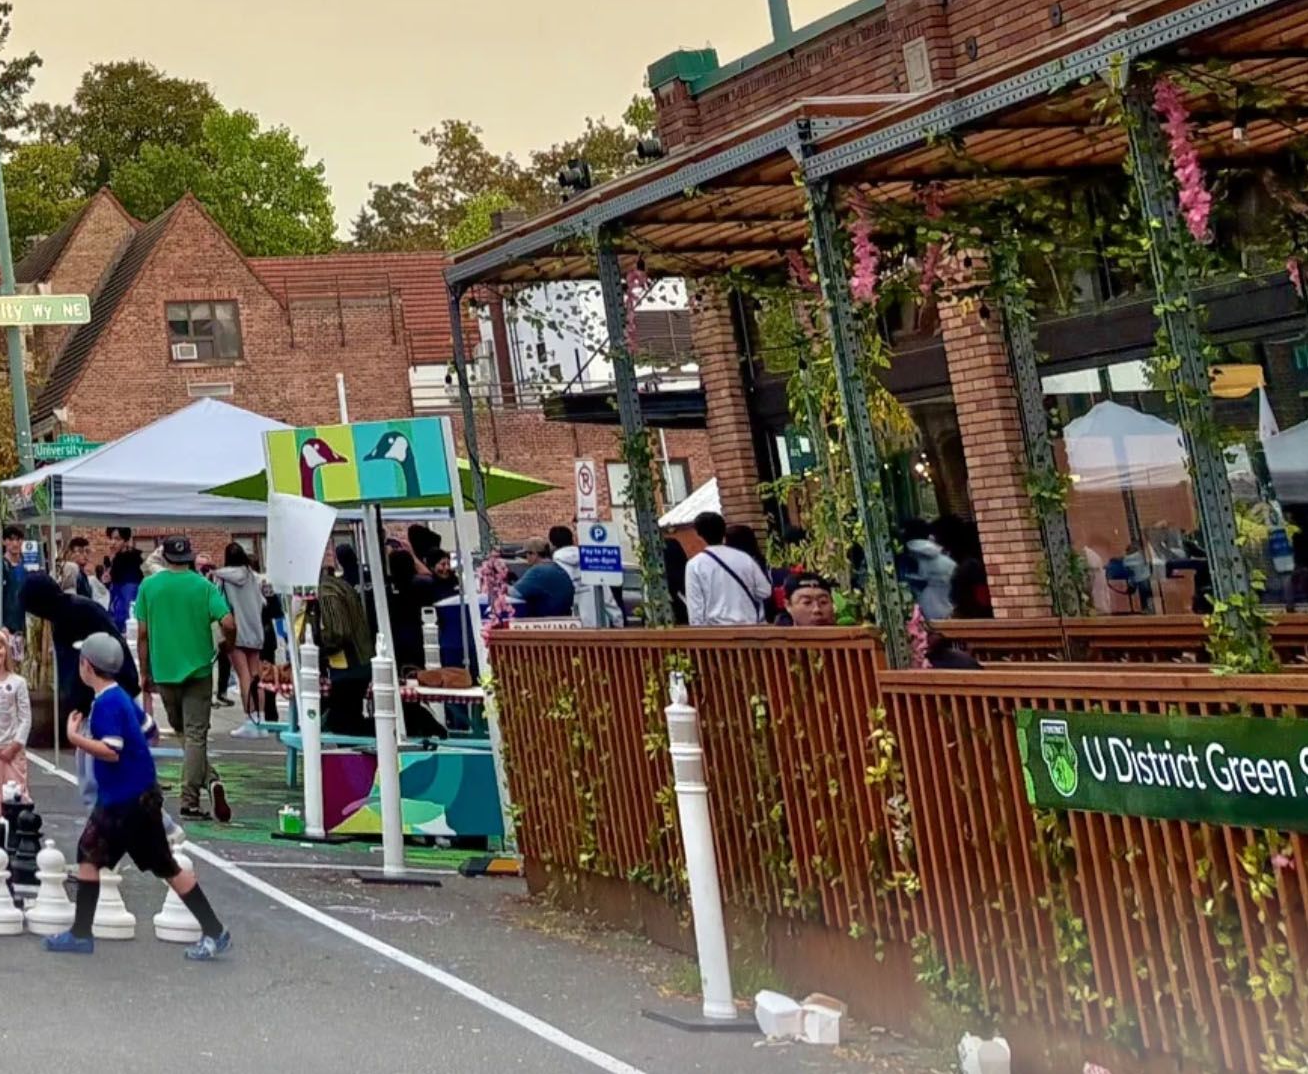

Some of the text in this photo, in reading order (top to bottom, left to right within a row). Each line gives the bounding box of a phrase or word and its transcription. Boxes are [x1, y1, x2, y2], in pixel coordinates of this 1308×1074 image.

[33, 303, 52, 320] Wy
[63, 303, 84, 317] NE
[36, 444, 84, 456] University
[1082, 735, 1108, 782] U
[1107, 737, 1207, 791] District
[1205, 742, 1297, 798] Green
